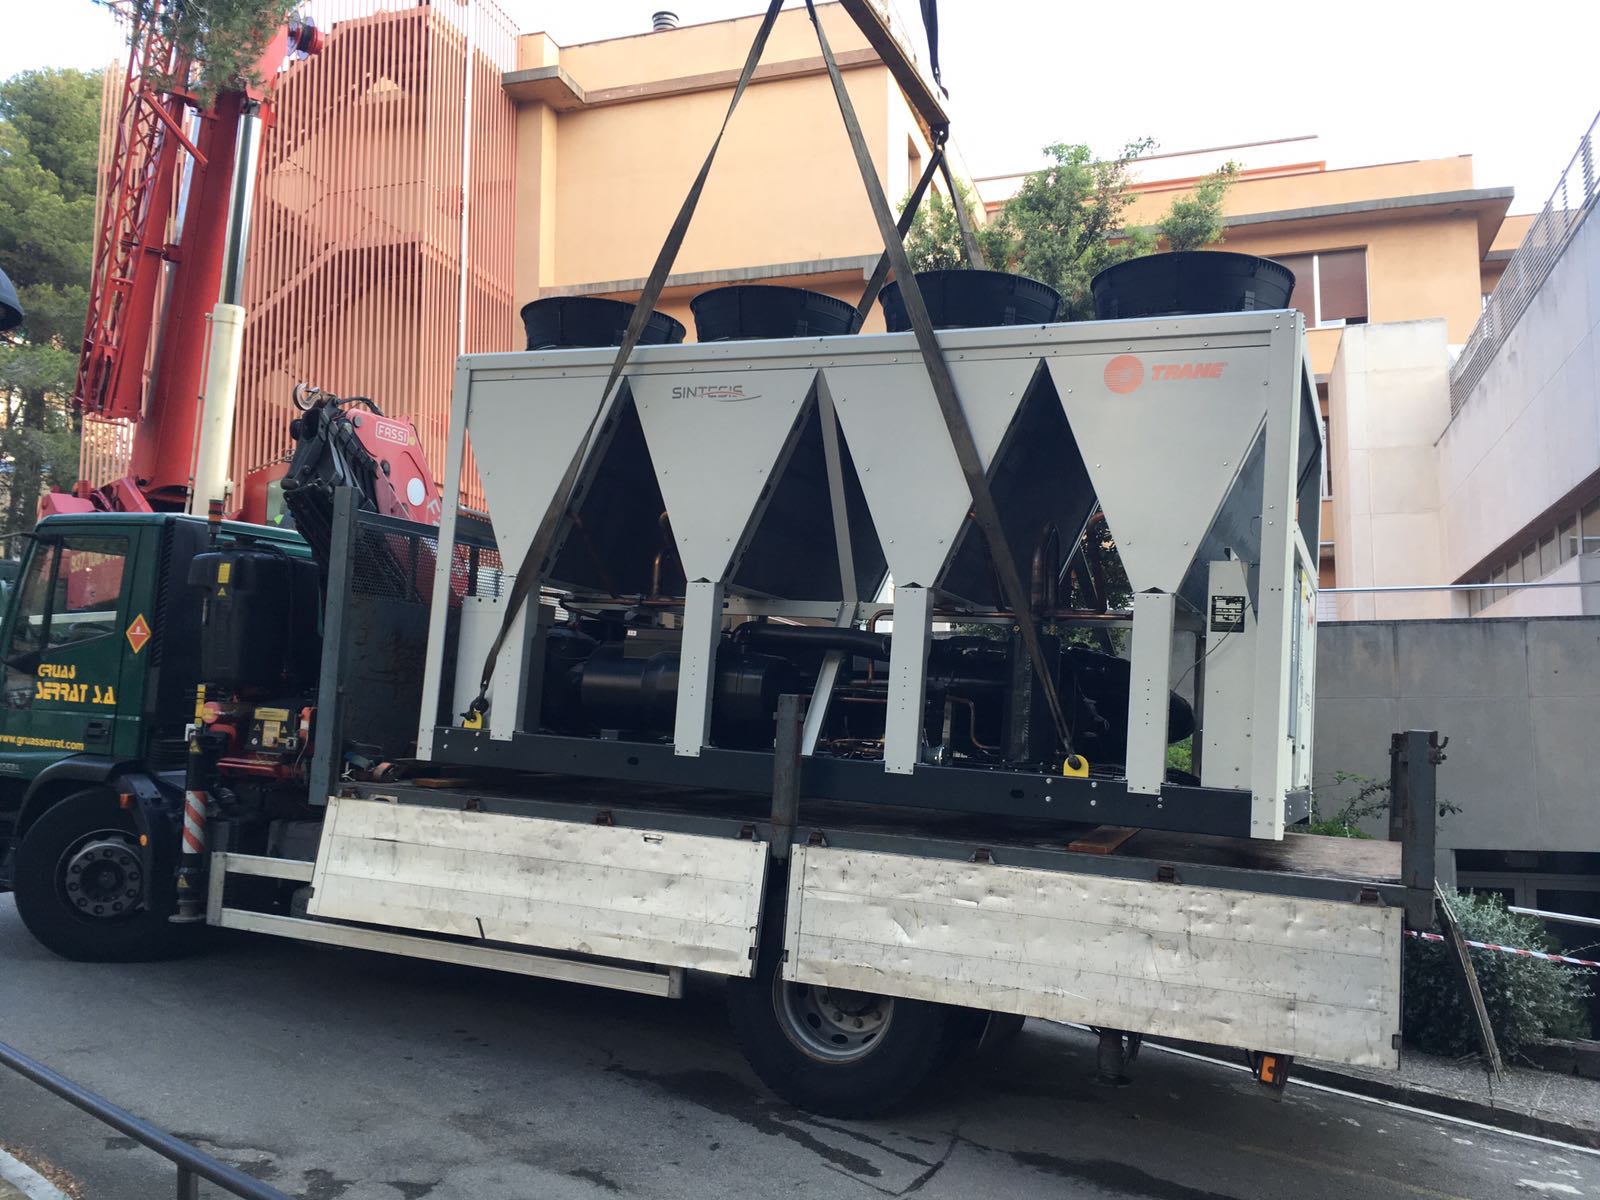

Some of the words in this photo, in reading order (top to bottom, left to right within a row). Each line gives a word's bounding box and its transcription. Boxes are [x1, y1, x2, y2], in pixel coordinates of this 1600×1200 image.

[1151, 362, 1225, 381] TRANE
[672, 385, 744, 400] SINTESIS
[377, 424, 408, 443] FASSI
[37, 663, 76, 679] GRUAS
[35, 681, 88, 703] SERRAT
[0, 734, 85, 751] ww.gruasserrat.com
